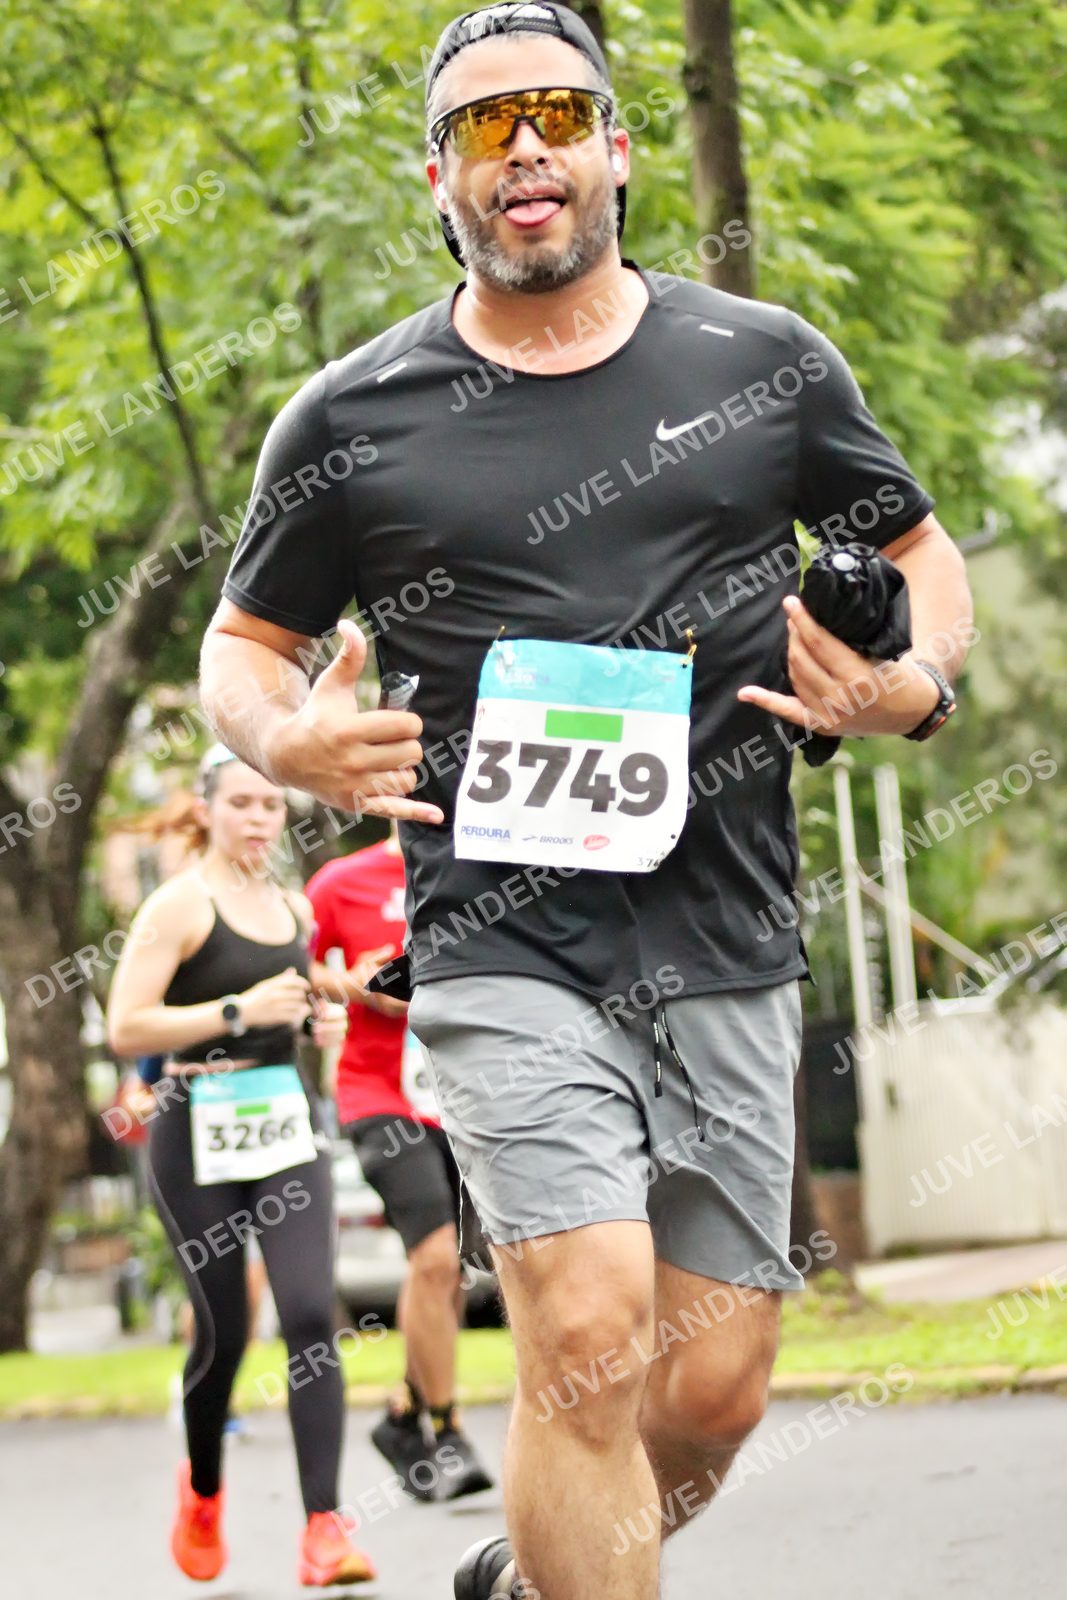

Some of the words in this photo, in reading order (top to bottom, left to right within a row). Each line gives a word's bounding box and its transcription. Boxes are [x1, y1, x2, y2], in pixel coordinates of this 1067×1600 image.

[467, 739, 669, 817] 3749
[460, 825, 511, 840] PERDURA
[539, 836, 574, 845] BROOKS
[207, 1115, 299, 1152] 3266
